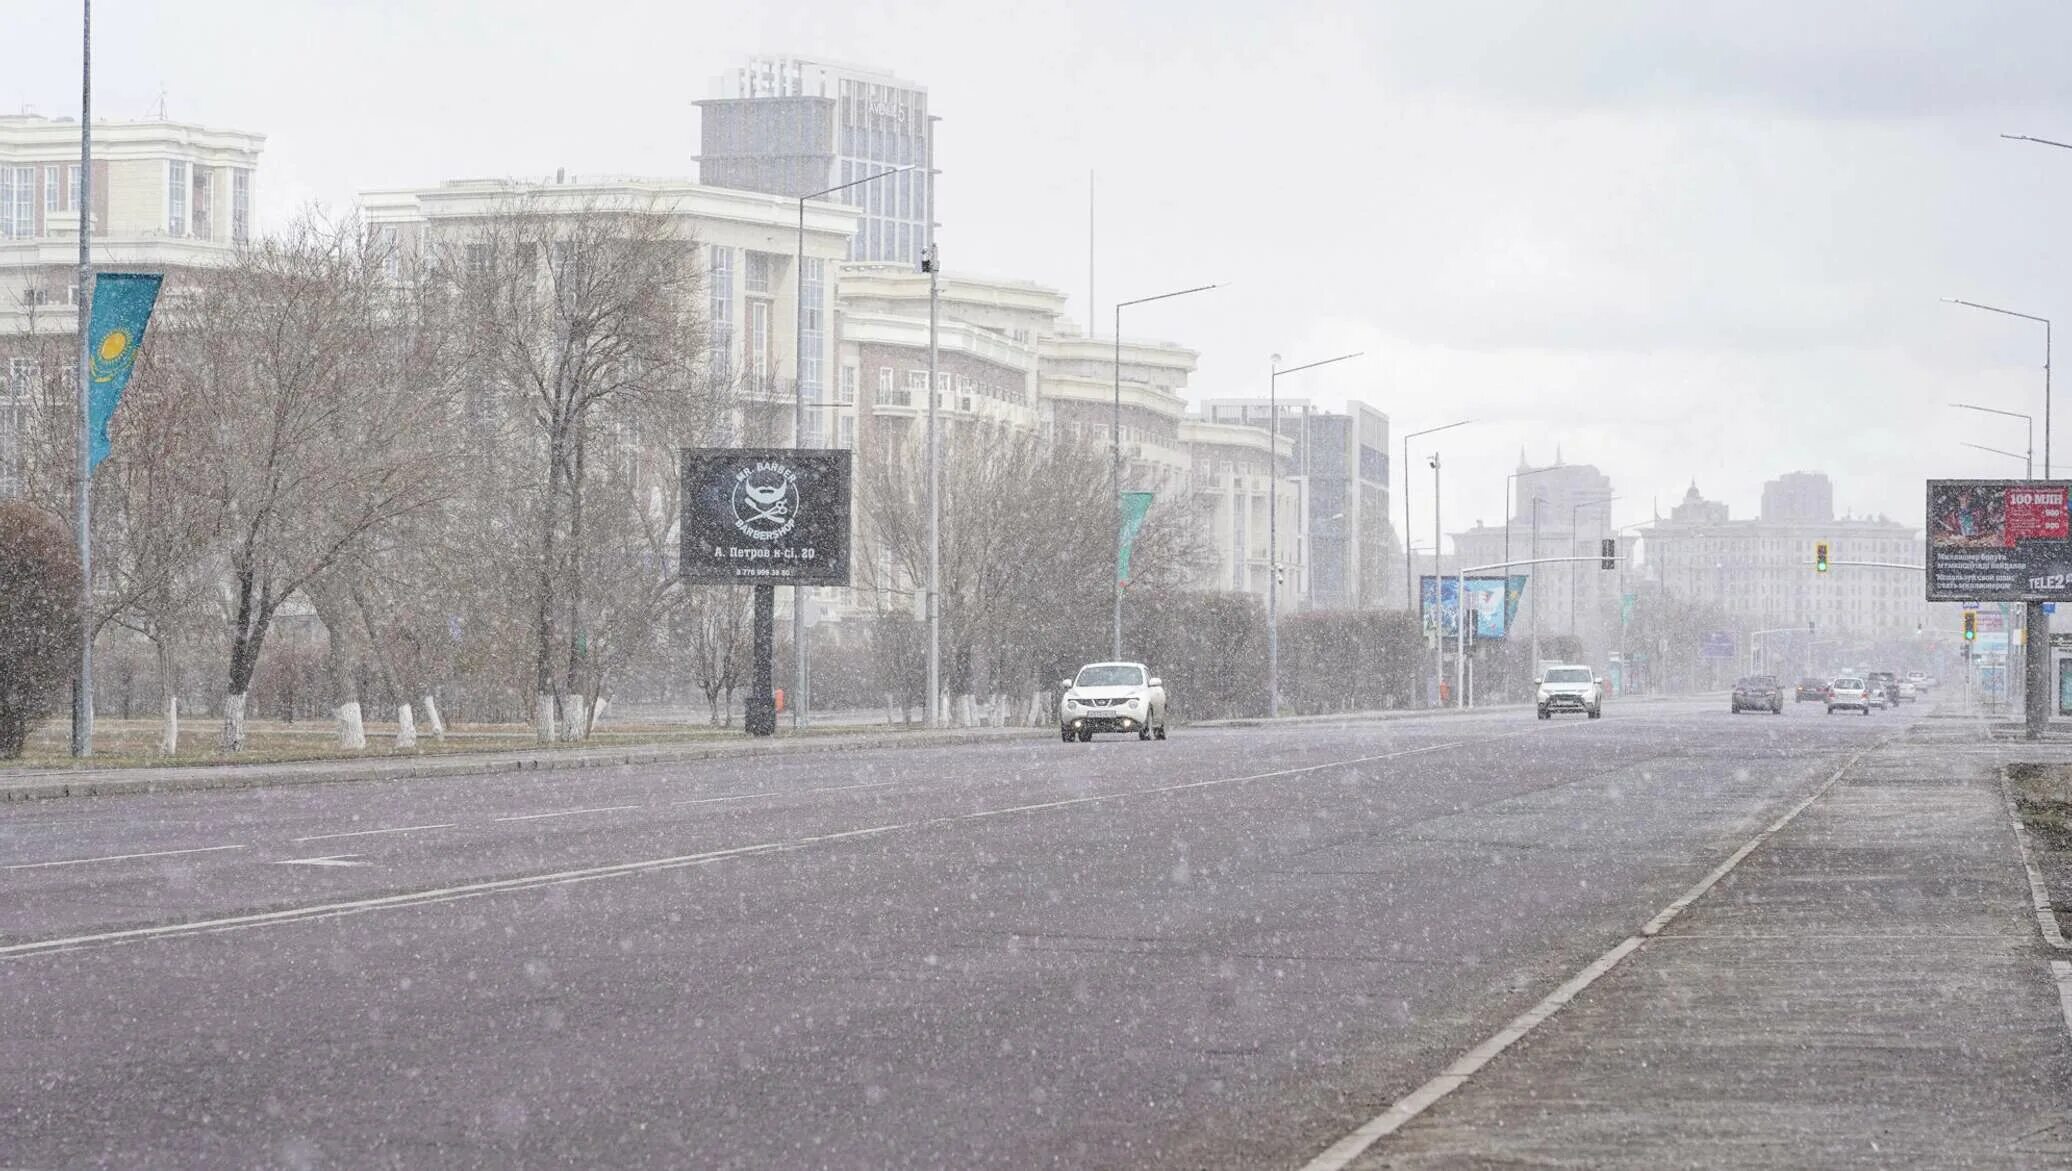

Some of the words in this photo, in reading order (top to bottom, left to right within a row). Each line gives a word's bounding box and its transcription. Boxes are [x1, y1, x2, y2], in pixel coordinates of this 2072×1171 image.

[736, 467, 753, 483] MR.
[756, 462, 798, 484] BARBER
[2010, 494, 2032, 505] 100
[734, 518, 796, 541] BARBERSHOP
[729, 547, 771, 561] Петров
[801, 548, 815, 559] 20
[2028, 574, 2066, 590] TELE2
